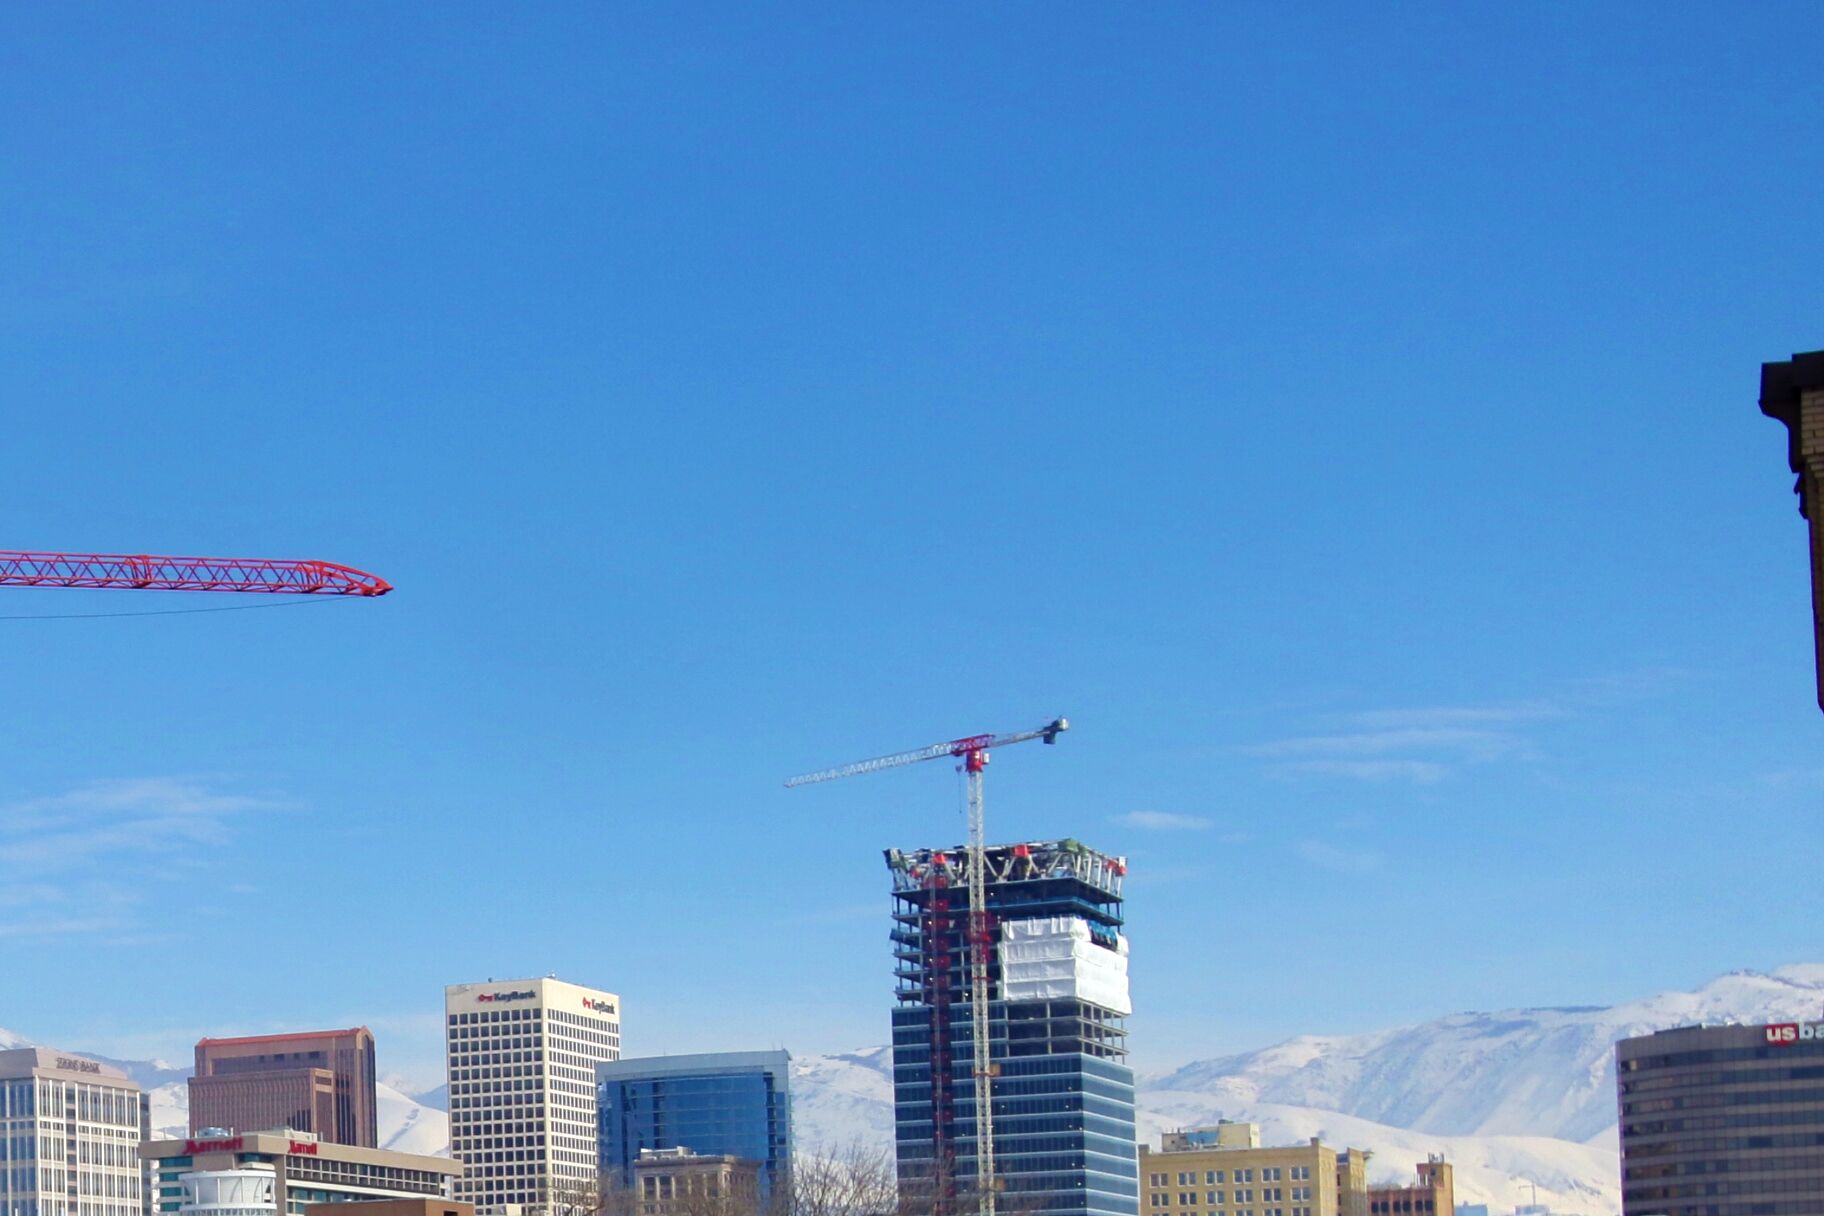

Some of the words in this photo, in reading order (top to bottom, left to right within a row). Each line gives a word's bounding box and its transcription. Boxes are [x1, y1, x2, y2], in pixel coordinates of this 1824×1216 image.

[494, 989, 536, 1003] KeyBank
[591, 999, 615, 1014] KeyBank
[79, 1060, 101, 1074] BANK
